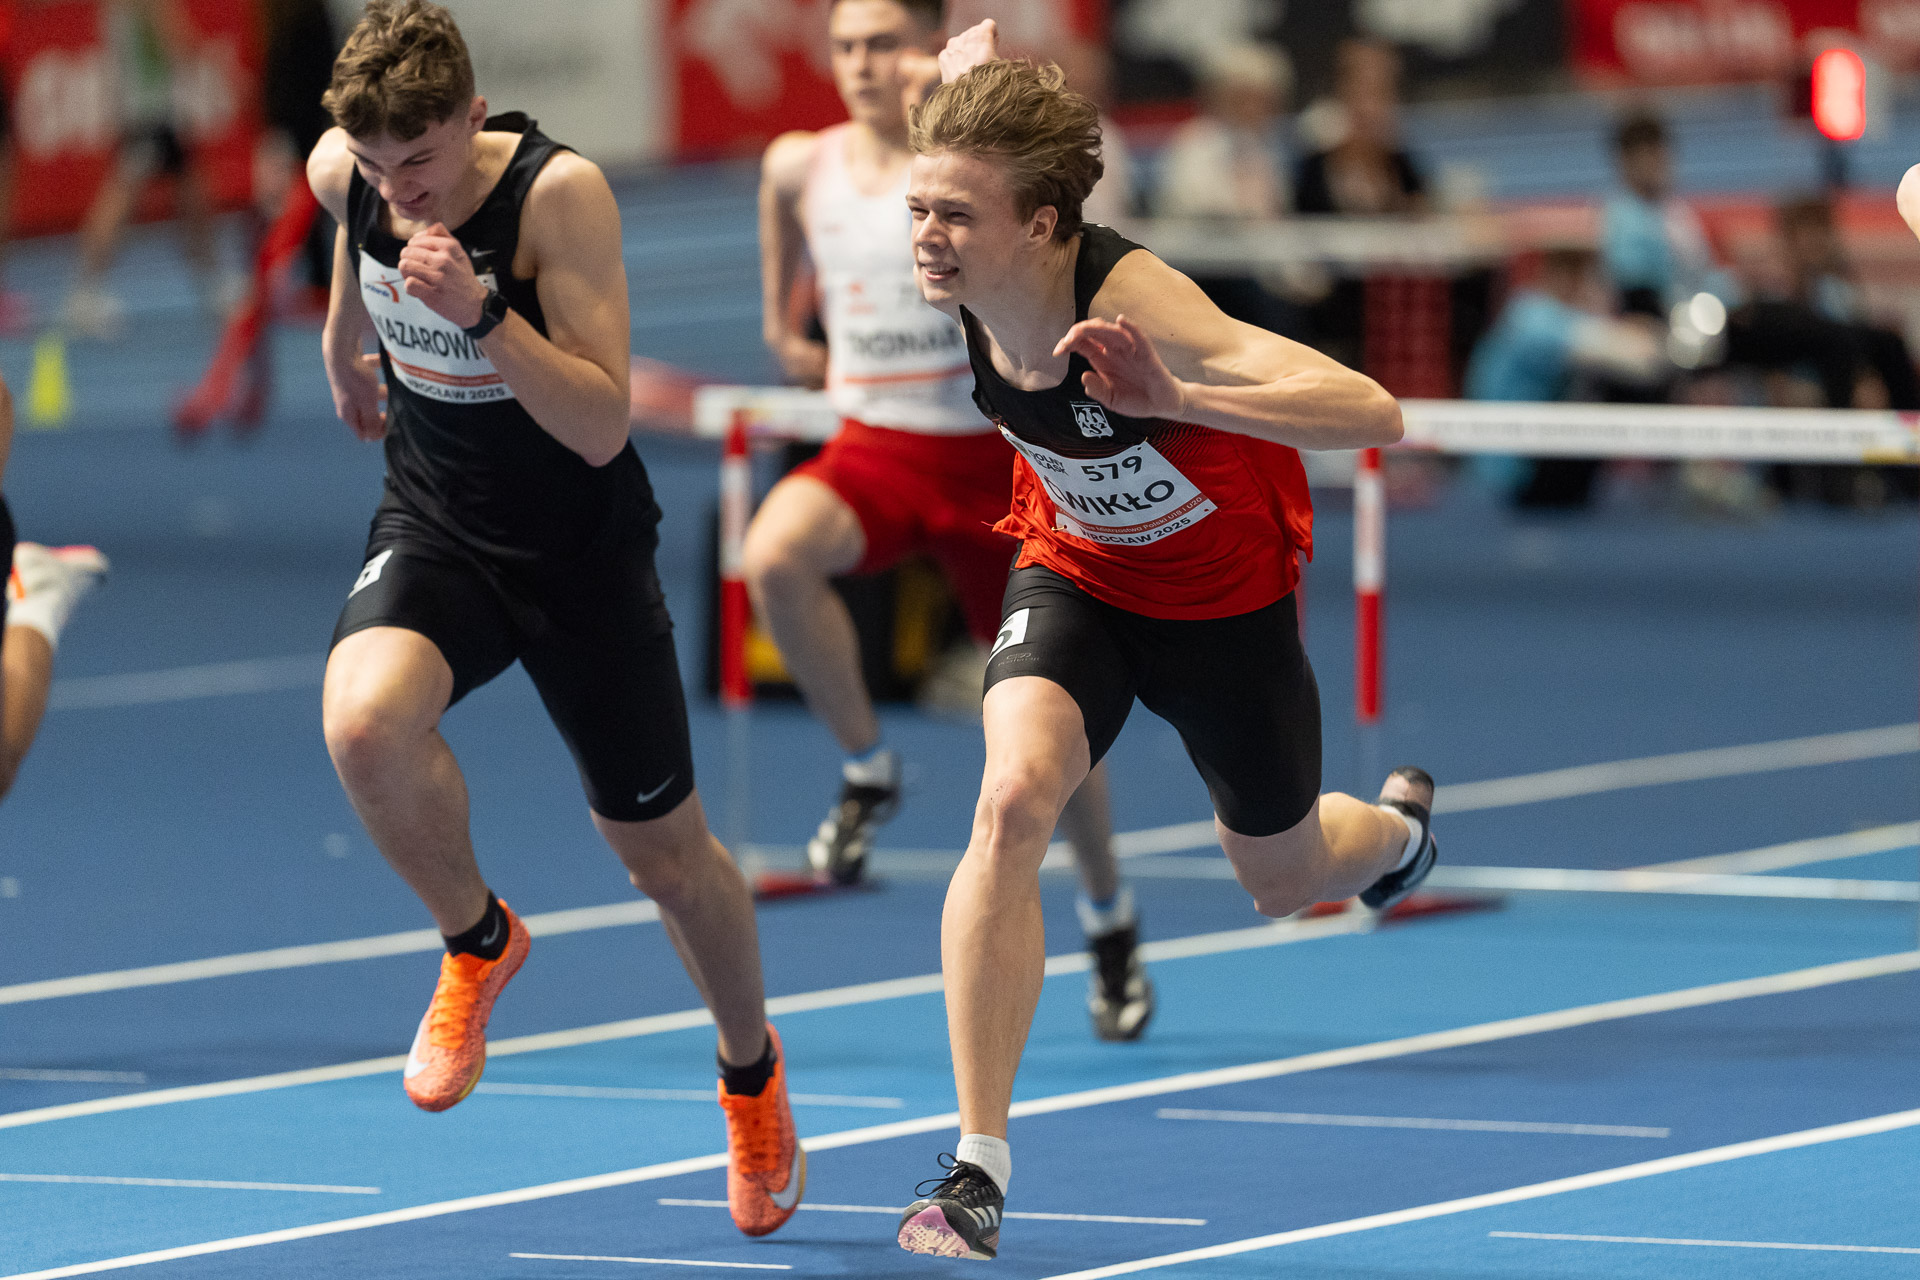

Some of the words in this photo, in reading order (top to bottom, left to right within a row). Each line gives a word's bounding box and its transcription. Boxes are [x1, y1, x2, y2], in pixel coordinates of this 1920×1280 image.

[468, 386, 505, 399] 2025
[1081, 455, 1143, 482] 579
[1142, 517, 1169, 531] Polski
[1167, 509, 1183, 520] U18
[1187, 497, 1203, 509] U20
[1079, 527, 1151, 544] WROCŁAW
[1154, 517, 1191, 537] 2025
